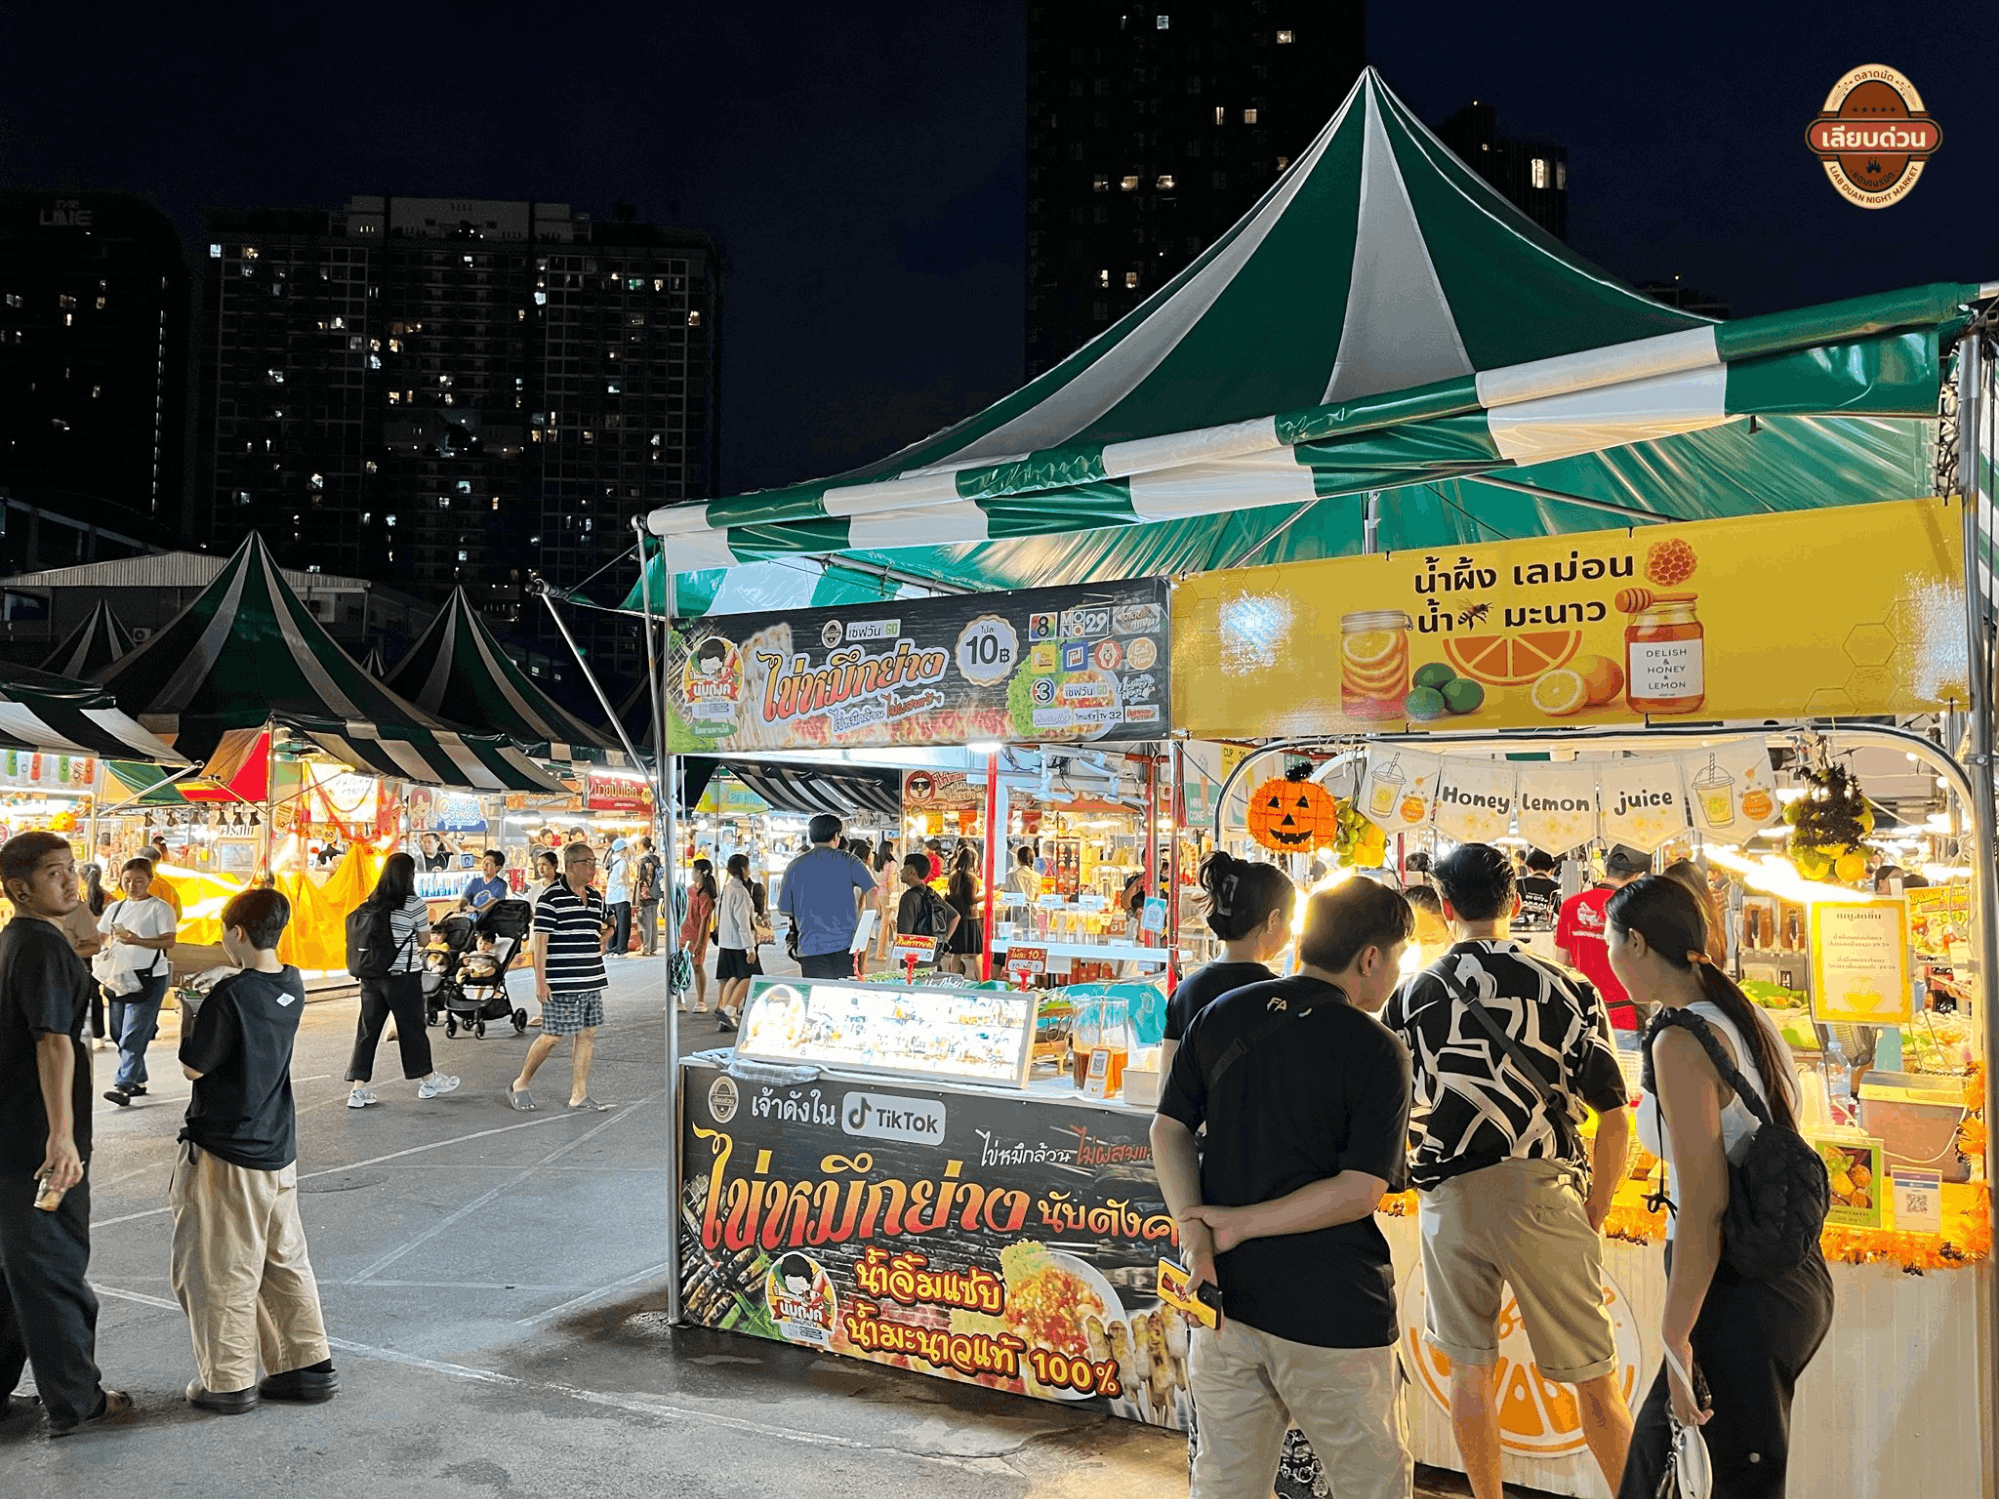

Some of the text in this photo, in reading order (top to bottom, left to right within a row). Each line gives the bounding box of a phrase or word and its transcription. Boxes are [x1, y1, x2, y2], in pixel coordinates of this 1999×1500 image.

[1414, 551, 1634, 594] น้ำผึ้ง เลม่อน
[1037, 615, 1050, 637] 8
[1085, 612, 1107, 633] 29
[1418, 598, 1607, 634] น้ำ มะนาว
[1646, 648, 1687, 658] DELISH
[755, 642, 945, 723] ไข่หมึกย่าง
[1647, 665, 1686, 674] HONEY
[1036, 682, 1050, 701] 3
[1648, 681, 1686, 690] LEMON
[1109, 710, 1122, 720] 32
[1189, 810, 1204, 821] CONE
[1442, 786, 1510, 815] Honey
[1522, 793, 1590, 812] lemon
[1614, 790, 1673, 816] juice
[751, 1086, 939, 1135] เจ้าดังใน TikTok
[975, 1124, 1155, 1167] ไข่หมึกล้วน ไม่ผสมแ
[690, 1120, 1180, 1254] ไข่หมึกย่าง นับตังค
[854, 1246, 1002, 1312] น้ำจิ้มแซ่บ
[844, 1300, 1120, 1397] น้ำมะนาวแท้ 100%
